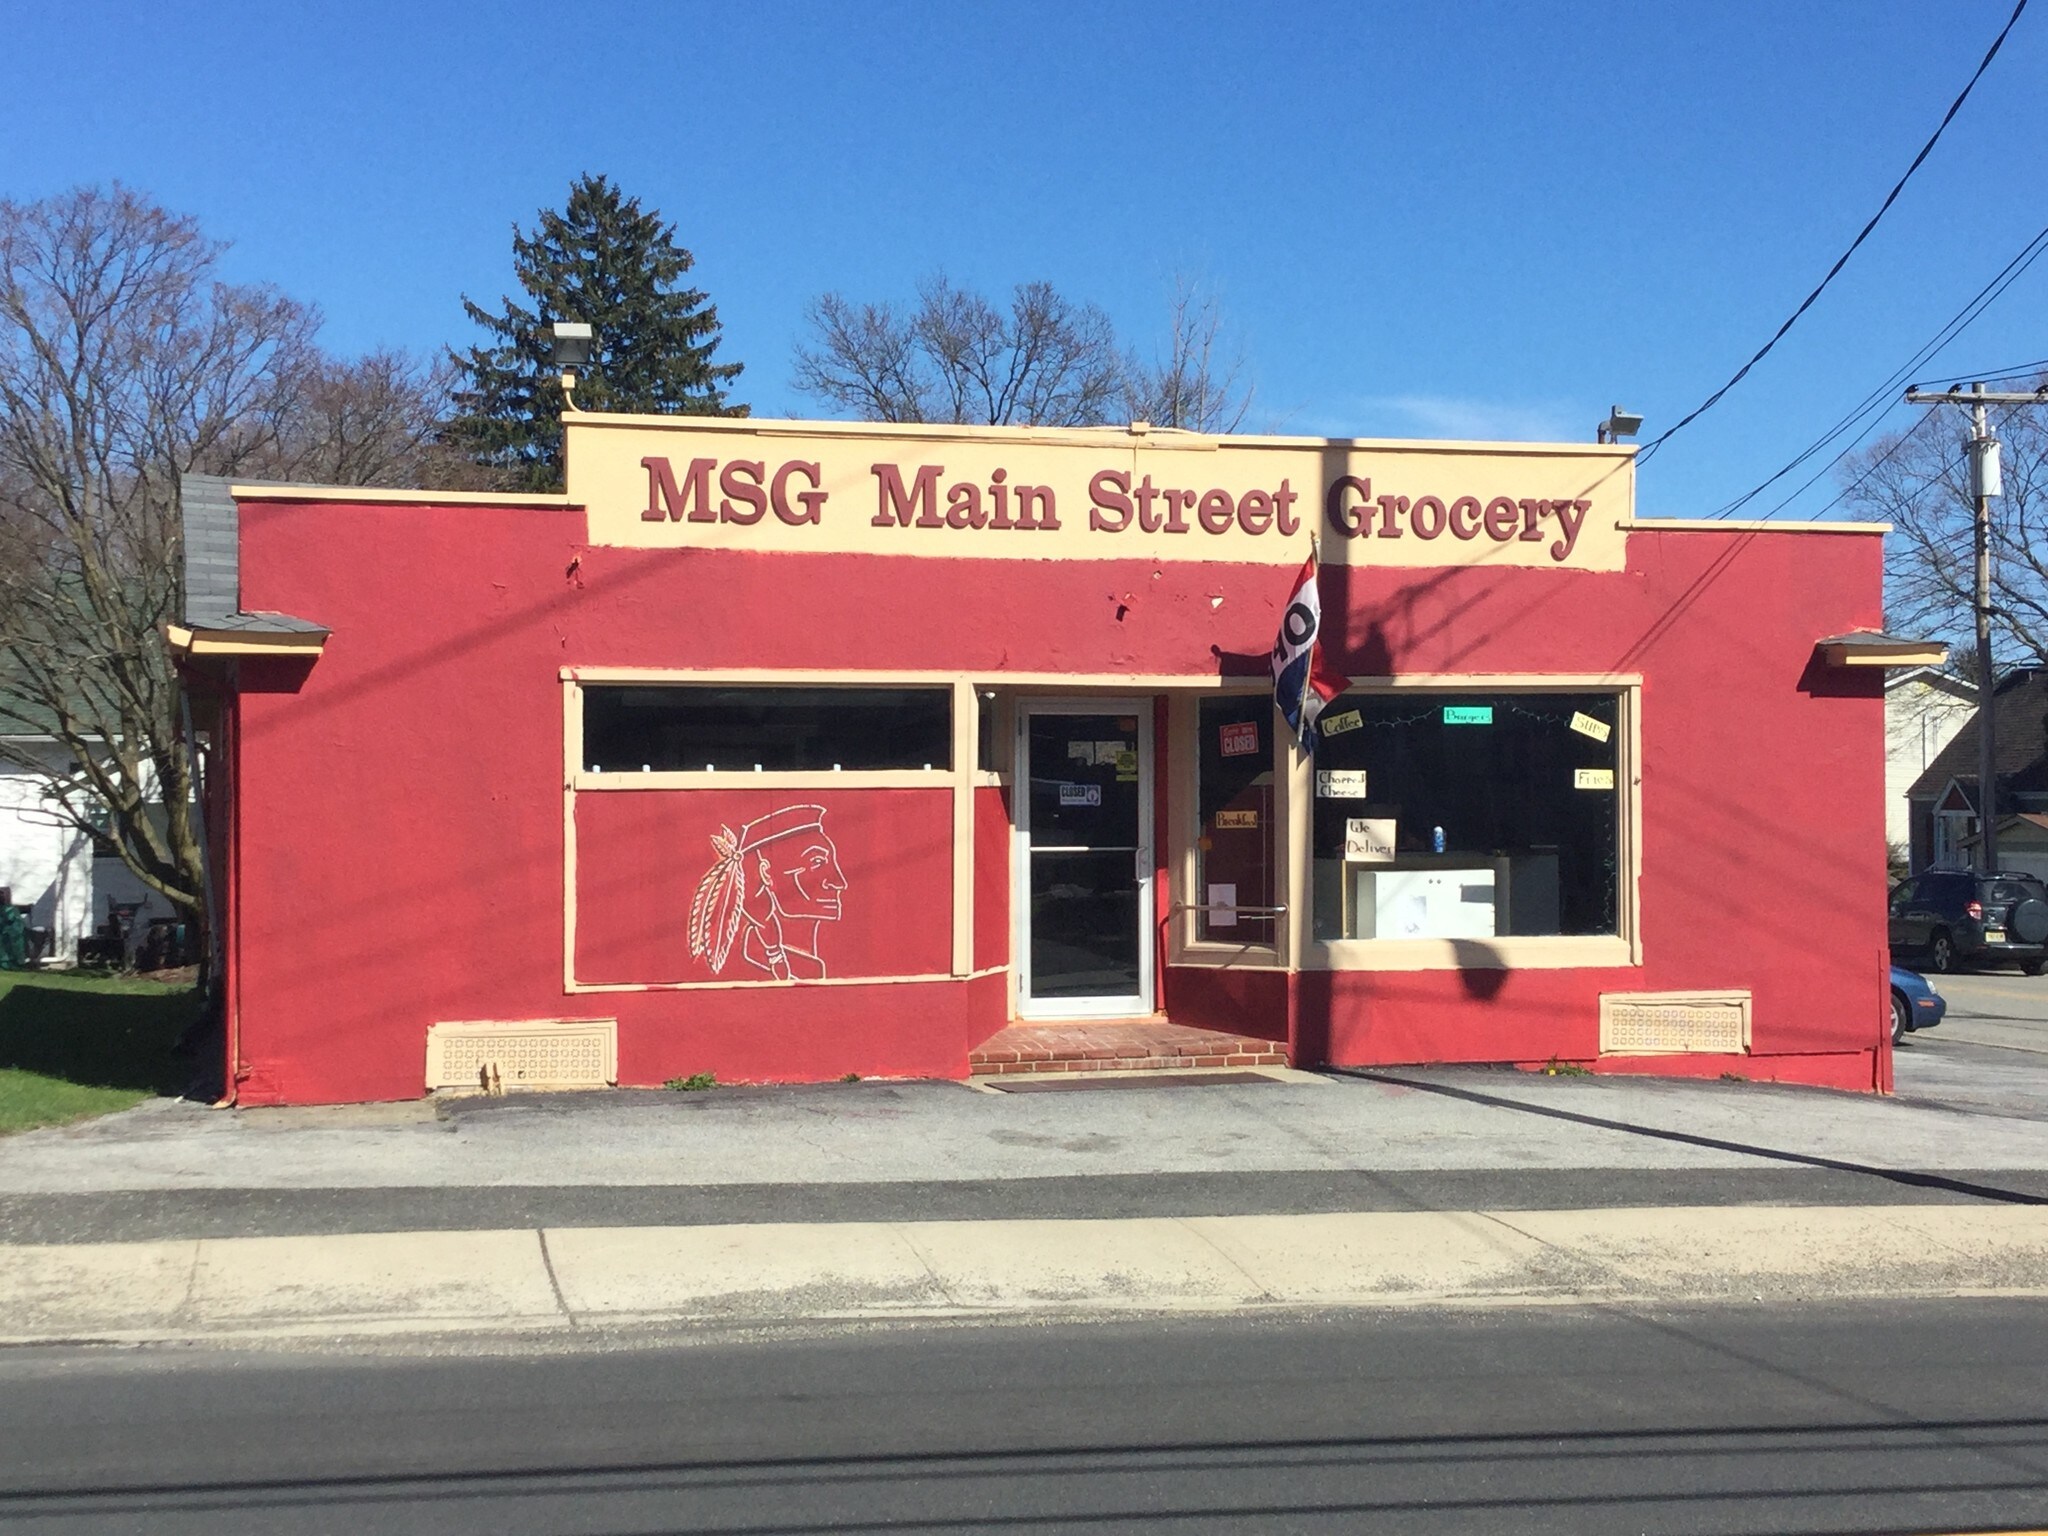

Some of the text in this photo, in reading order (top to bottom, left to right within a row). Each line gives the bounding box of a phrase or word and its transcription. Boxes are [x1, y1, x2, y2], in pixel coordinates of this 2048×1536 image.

[641, 457, 1592, 562] MSG Main Street Grocery
[1324, 714, 1361, 734] Coffee
[1223, 734, 1256, 755] CLOSED
[1578, 771, 1614, 785] Fries
[1061, 785, 1086, 798] CLOSED
[1320, 784, 1359, 796] Cheese
[1349, 821, 1371, 834] We
[1346, 840, 1392, 854] Deliver
